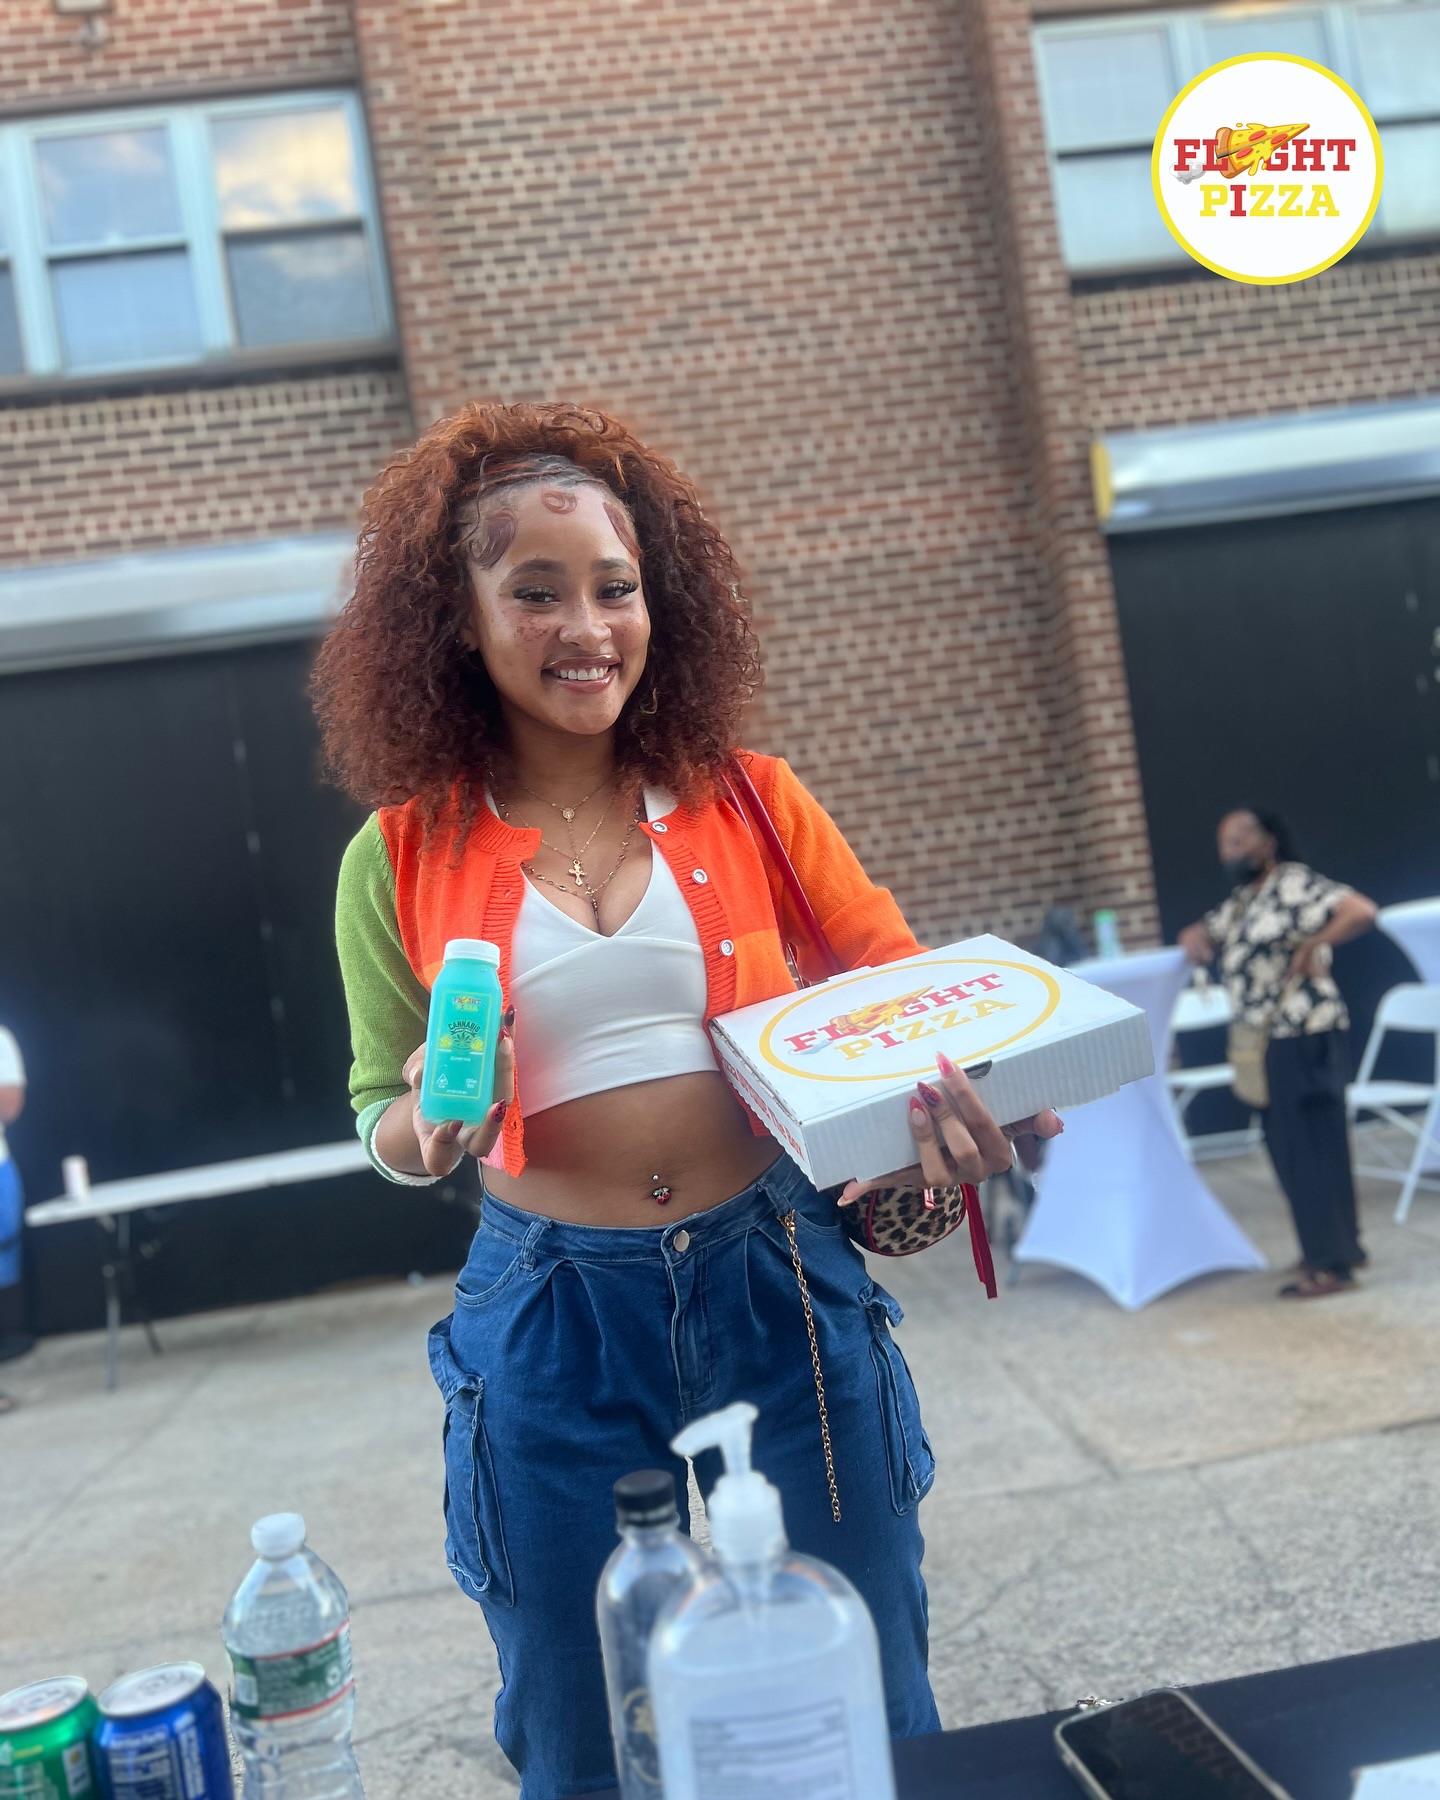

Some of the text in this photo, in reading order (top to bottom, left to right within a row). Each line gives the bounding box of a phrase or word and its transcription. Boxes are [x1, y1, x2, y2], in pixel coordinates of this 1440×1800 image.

[448, 1020, 481, 1033] CANNABIS
[783, 973, 1005, 1053] FLGHT
[834, 998, 1018, 1061] PIZZA
